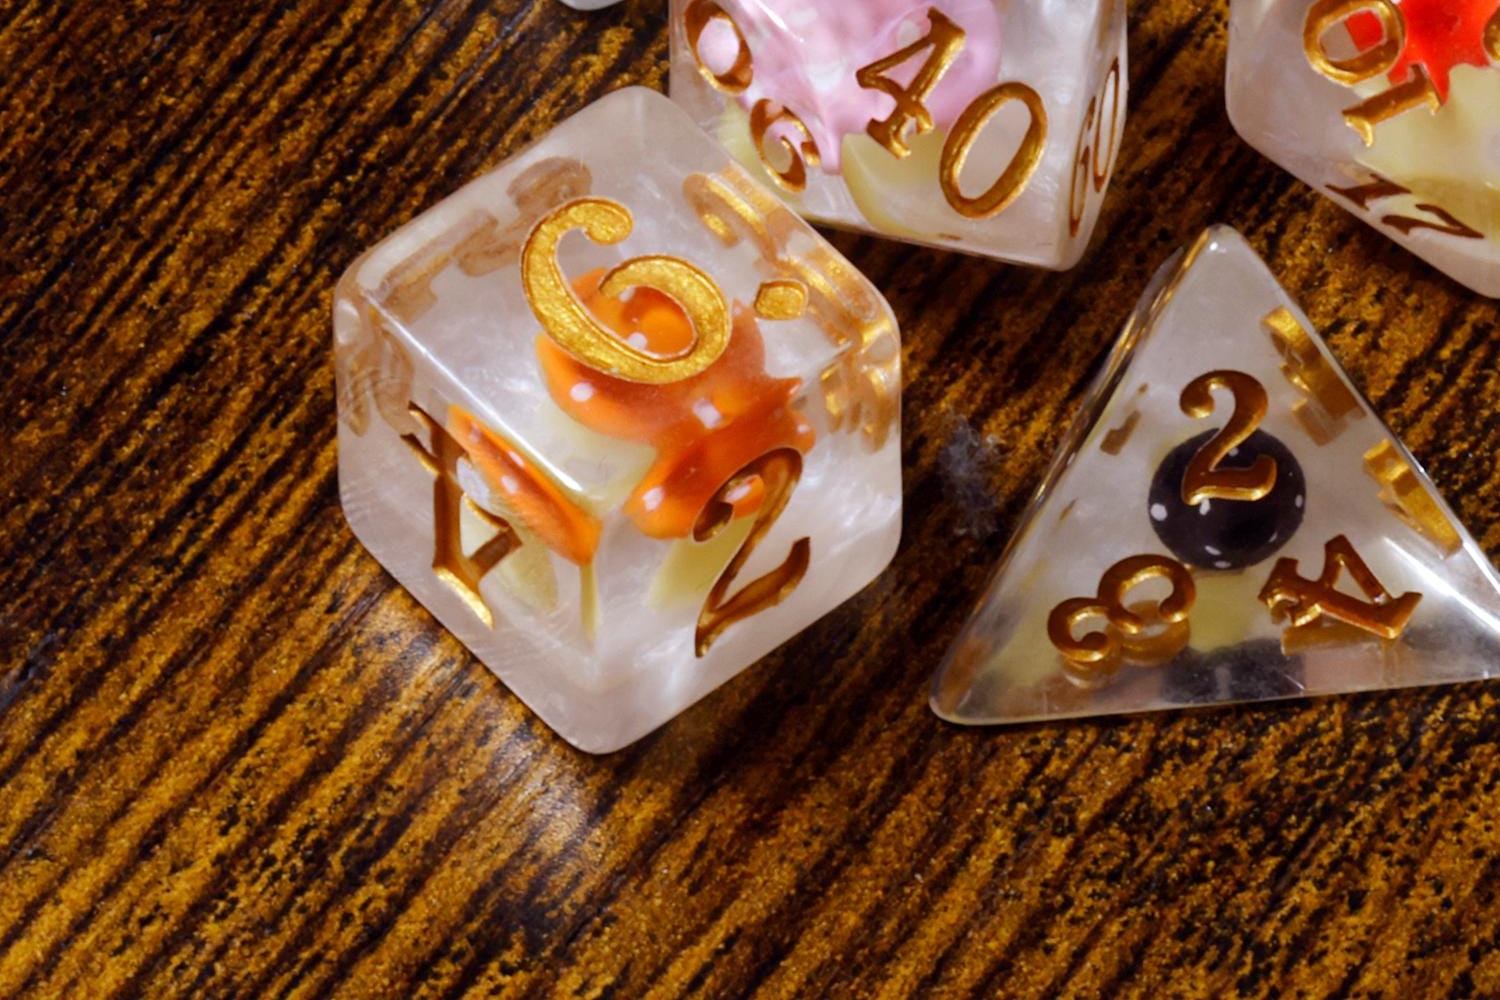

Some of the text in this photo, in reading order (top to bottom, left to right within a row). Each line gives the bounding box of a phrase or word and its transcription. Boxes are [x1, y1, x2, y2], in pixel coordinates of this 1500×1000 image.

[855, 6, 1049, 219] 40
[1178, 369, 1277, 506] 2
[692, 446, 812, 658] 2
[1047, 553, 1197, 663] 3
[1257, 533, 1424, 640] 4
